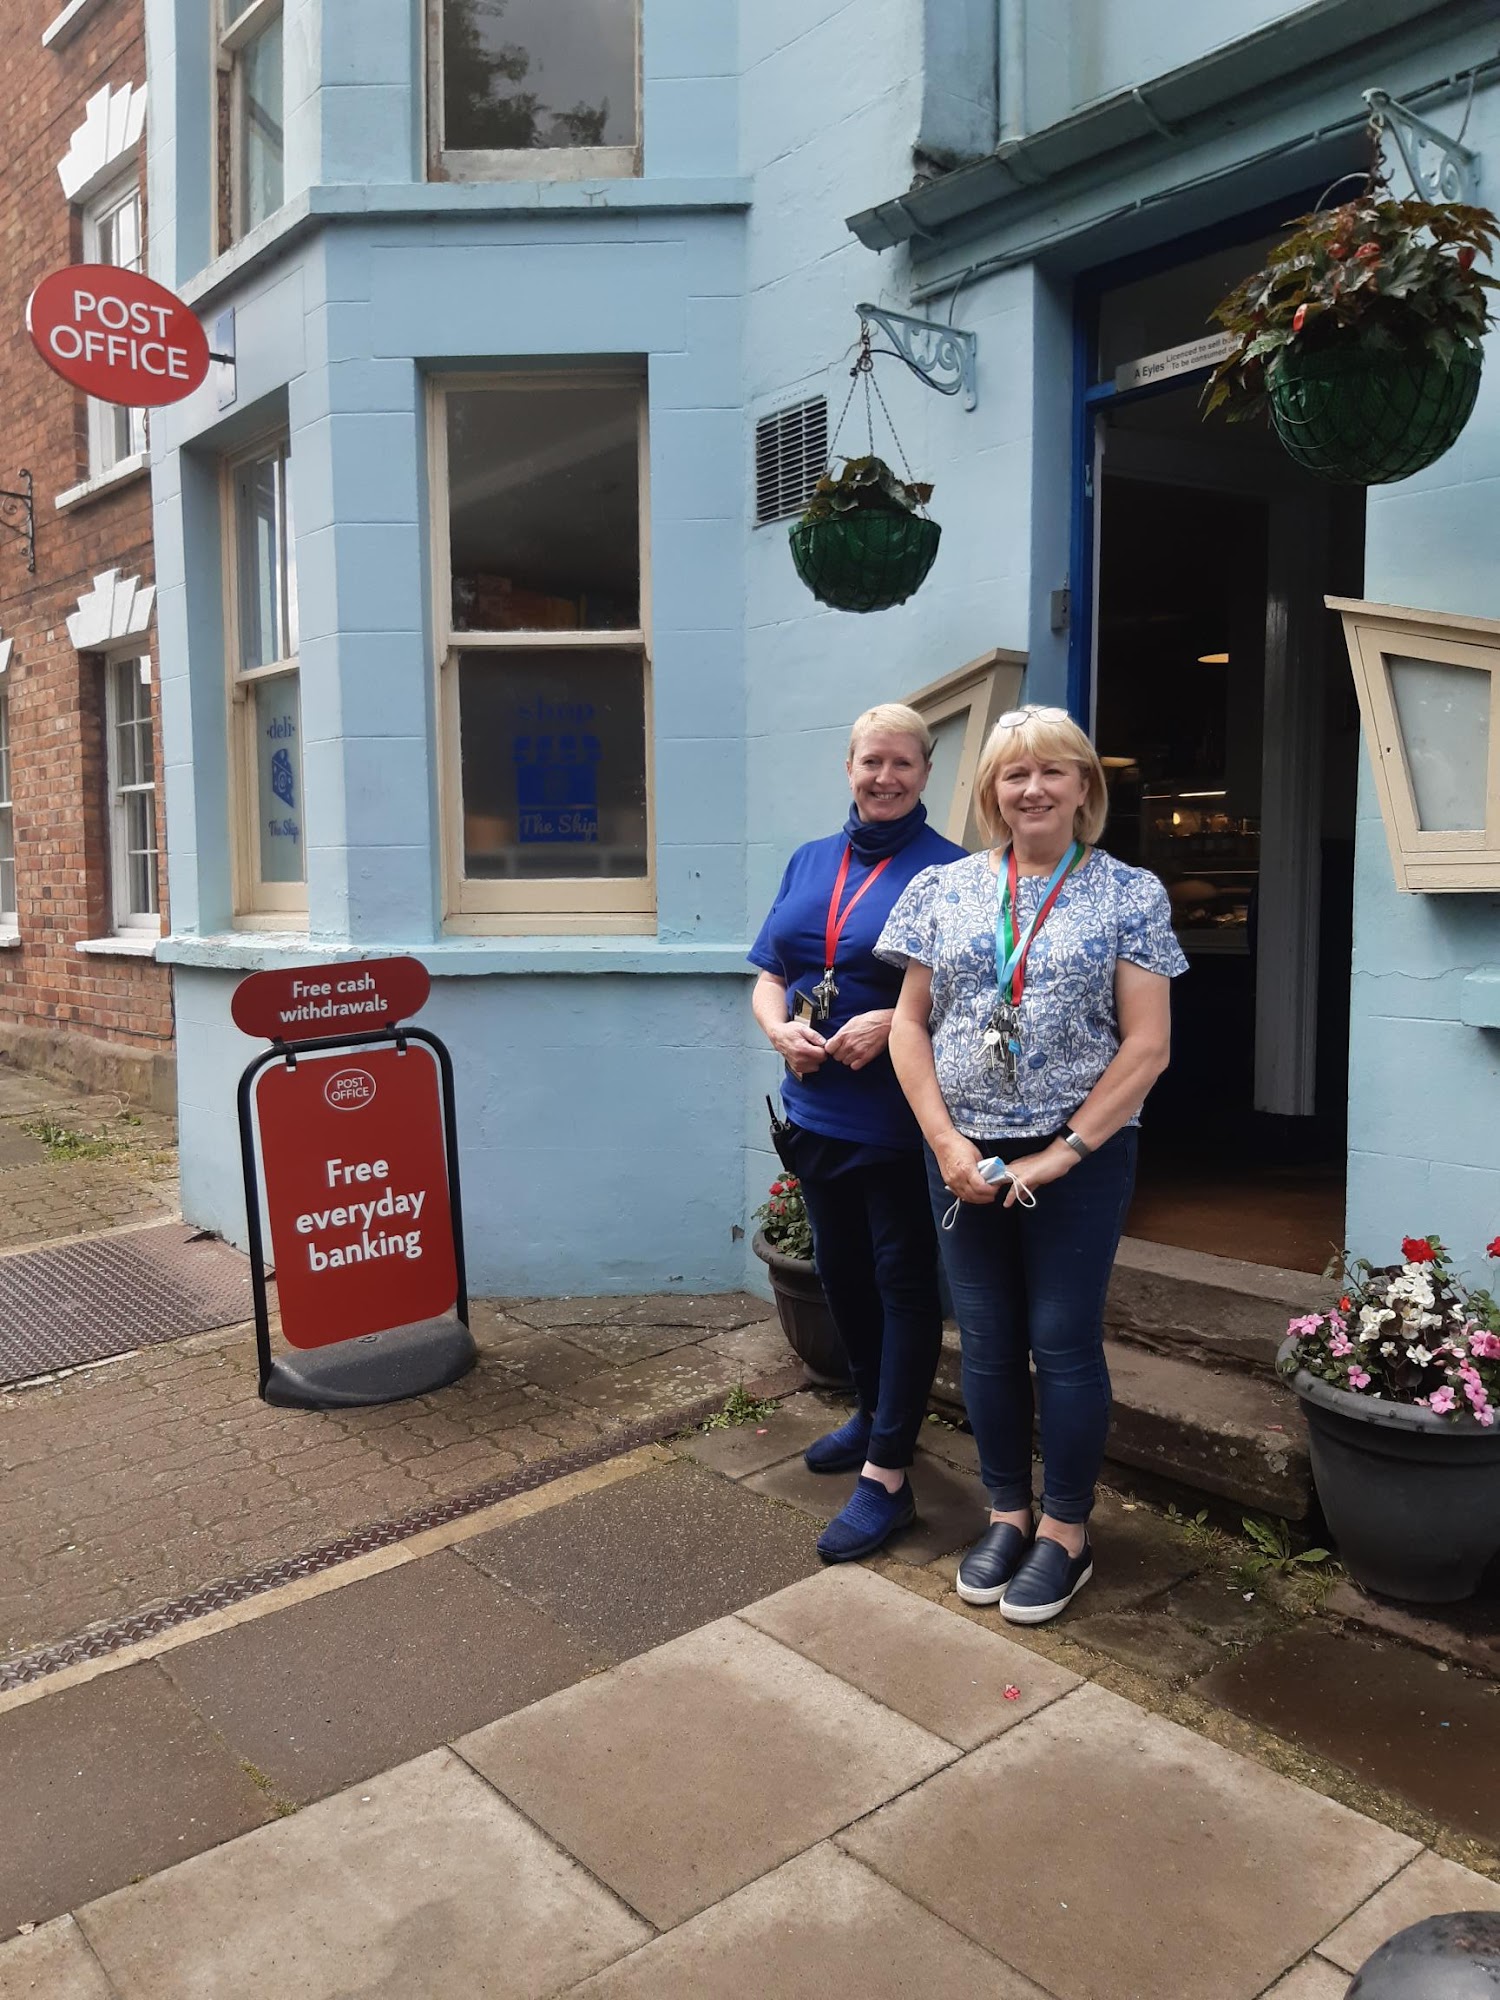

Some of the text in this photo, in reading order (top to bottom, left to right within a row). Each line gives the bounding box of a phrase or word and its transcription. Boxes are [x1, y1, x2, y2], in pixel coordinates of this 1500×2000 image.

[73, 290, 174, 338] POST
[49, 324, 190, 380] OFFICE
[1166, 346, 1197, 363] Licenced
[1199, 344, 1207, 353] to
[1208, 338, 1221, 350] sell
[1172, 361, 1180, 370] To
[1182, 359, 1190, 368] be
[1191, 347, 1227, 364] consumed
[1134, 362, 1165, 379] A Eyles
[518, 693, 595, 725] shop
[269, 820, 283, 836] The
[523, 813, 597, 842] The Ship
[292, 972, 376, 999] Free cash
[280, 993, 387, 1023] withdrawals
[331, 1086, 369, 1101] OFFICE
[336, 1077, 364, 1089] POST
[327, 1158, 389, 1188] Free
[296, 1187, 426, 1234] everyday
[308, 1230, 422, 1272] banking
